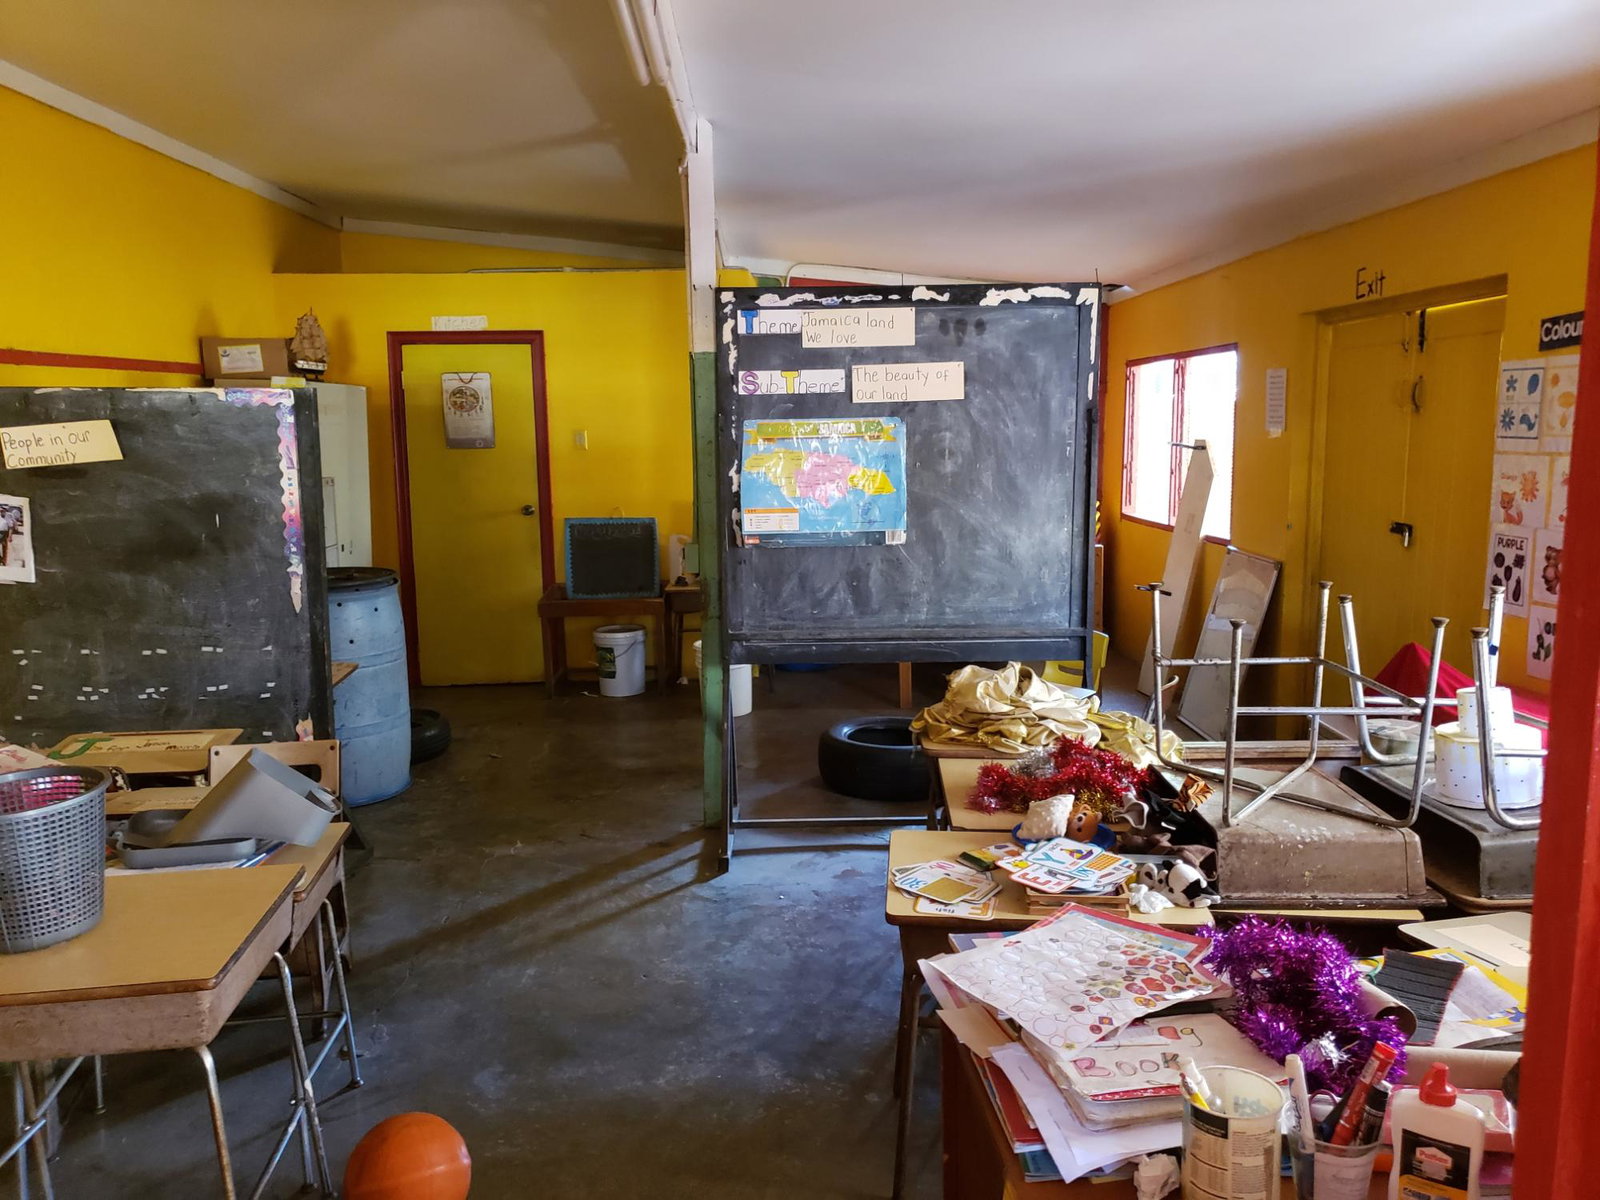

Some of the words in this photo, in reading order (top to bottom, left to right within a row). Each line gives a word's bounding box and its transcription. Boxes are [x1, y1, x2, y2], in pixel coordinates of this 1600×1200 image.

[1355, 267, 1387, 300] Exit
[741, 310, 798, 335] Theme
[802, 311, 861, 328] Jamaica
[866, 312, 895, 330] land
[806, 330, 822, 344] We
[830, 330, 858, 344] love
[853, 367, 879, 382] The
[884, 366, 929, 386] beauty
[935, 369, 949, 382] of
[881, 385, 908, 401] land
[1, 431, 44, 454] People
[50, 434, 63, 446] in
[6, 448, 76, 468] Community
[1497, 537, 1525, 551] PURPLE
